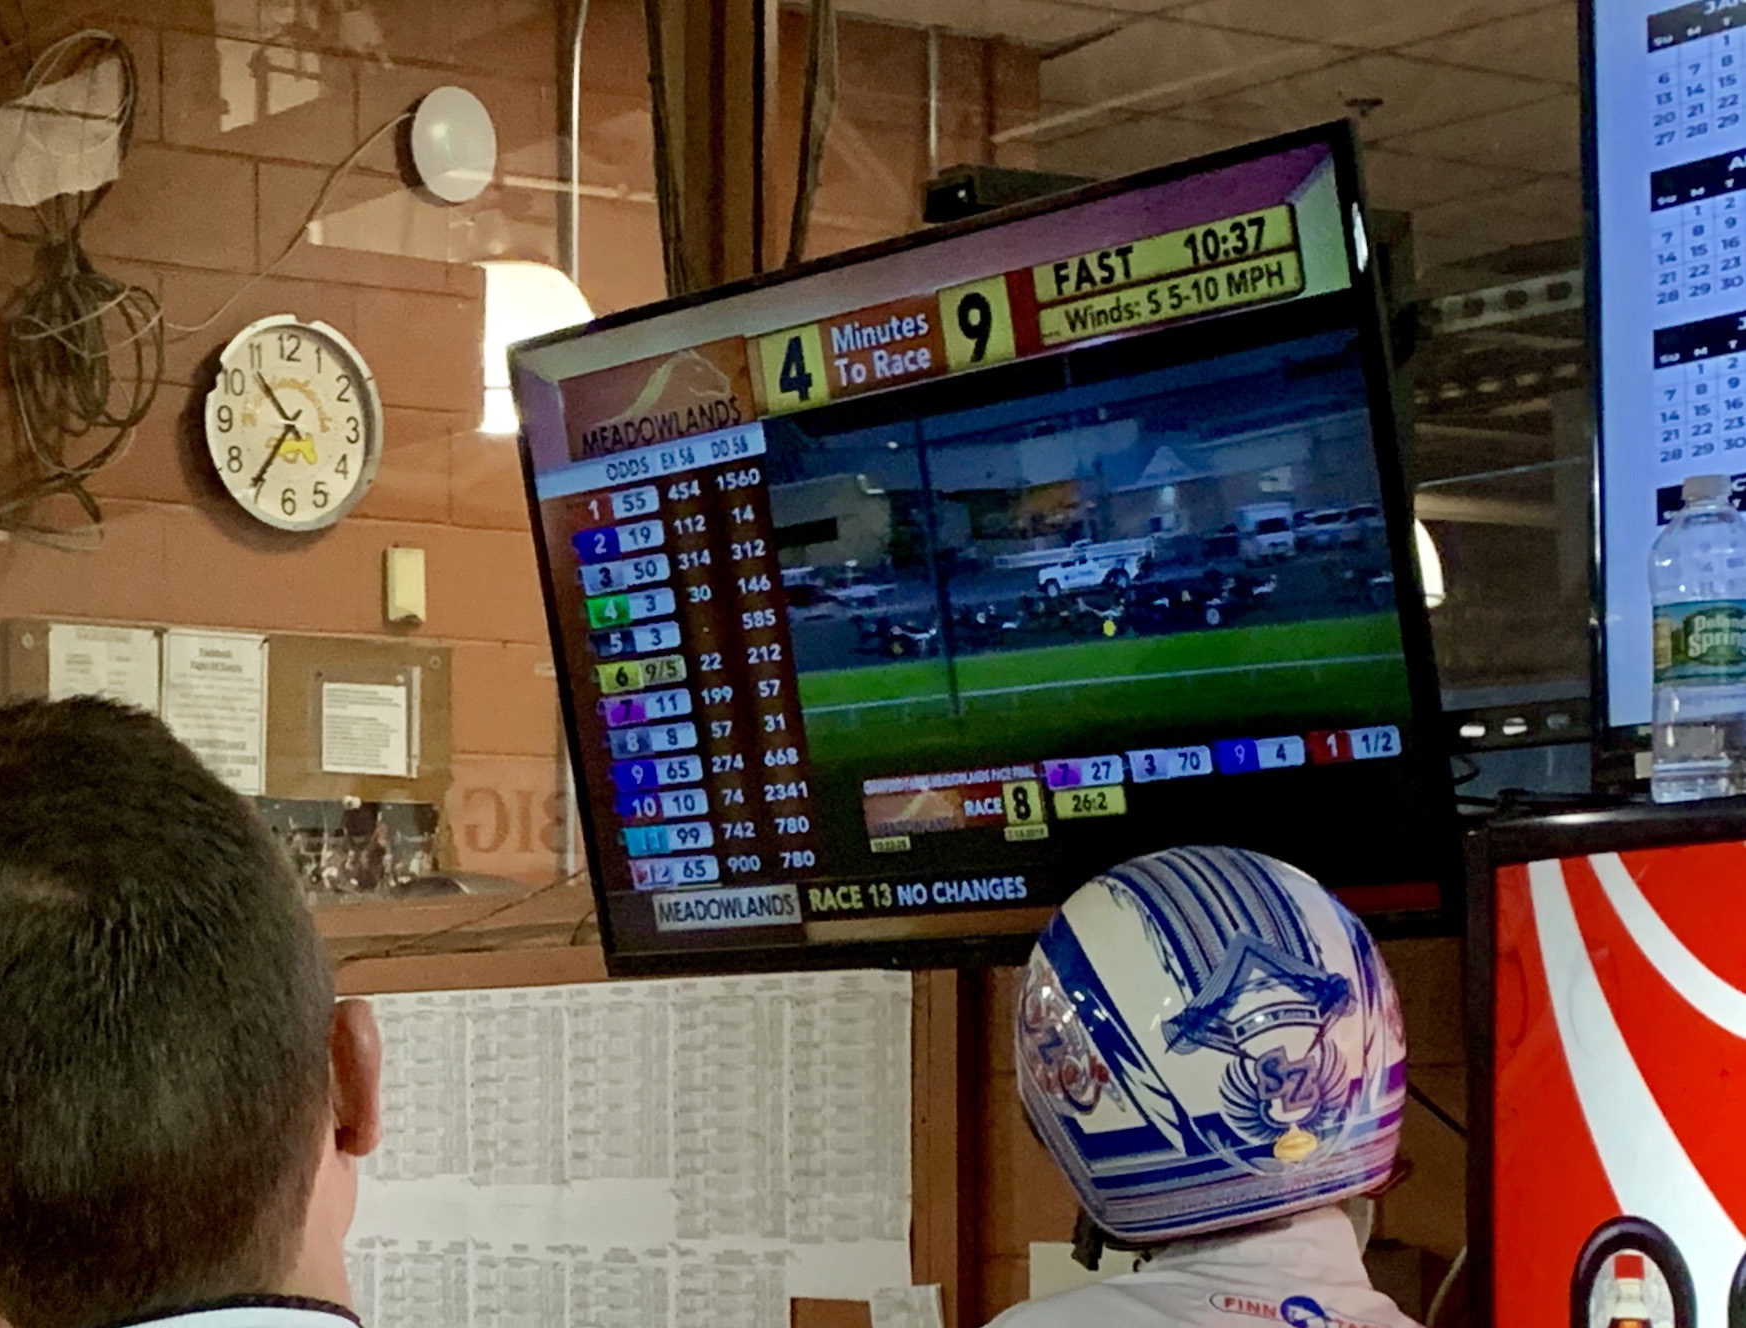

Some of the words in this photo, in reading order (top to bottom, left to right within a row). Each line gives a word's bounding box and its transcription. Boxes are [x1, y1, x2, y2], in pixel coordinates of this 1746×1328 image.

[1688, 63, 1701, 76] 7
[1686, 83, 1705, 97] 14
[1718, 73, 1737, 88] 15
[1653, 111, 1675, 127] 20
[1687, 103, 1704, 118] 21
[1717, 93, 1738, 109] 22
[1655, 130, 1675, 146] 27
[1685, 122, 1708, 138] 28
[1717, 113, 1739, 129] 29
[1724, 196, 1735, 210] 2
[1657, 252, 1677, 265] 14
[1690, 243, 1708, 257] 15
[1721, 236, 1741, 250] 16
[1661, 231, 1673, 244] 7
[1053, 245, 1134, 296] FAST
[1183, 216, 1266, 266] 10:37
[1659, 271, 1676, 286] 21
[1689, 263, 1710, 278] 22
[1721, 256, 1741, 272] 23
[1064, 295, 1141, 334] Winds:
[1167, 276, 1220, 311] 5-10
[1225, 260, 1285, 297] MPH
[1656, 289, 1679, 306] 28
[1688, 282, 1711, 298] 29
[1720, 275, 1744, 291] 30
[830, 312, 930, 355] Minutes
[957, 292, 993, 363] 9
[248, 342, 262, 370] 11
[277, 333, 302, 363] 12
[315, 345, 324, 374] 1
[1727, 356, 1738, 370] 2
[779, 335, 812, 401] 4
[833, 357, 867, 387] To
[872, 346, 932, 379] Race
[221, 367, 246, 397] 10
[335, 373, 352, 403] 2
[1664, 388, 1676, 401] 7
[216, 404, 234, 434] 9
[1660, 410, 1679, 423] 14
[1694, 403, 1711, 416] 15
[1724, 397, 1744, 411] 16
[345, 416, 361, 445] 3
[580, 396, 742, 456] MEADOWLANDS
[1662, 428, 1679, 443] 21
[1691, 422, 1713, 437] 22
[1724, 416, 1745, 431] 23
[226, 445, 244, 474] 8
[1660, 448, 1682, 463] 28
[1692, 443, 1714, 457] 29
[1724, 436, 1746, 451] 30
[334, 453, 350, 480] 4
[606, 455, 650, 482] ODDS
[280, 487, 297, 516] 6
[312, 481, 329, 509] 5
[588, 500, 600, 521] 1
[621, 493, 647, 513] 55
[667, 480, 701, 501] 454
[715, 468, 761, 491] 1560
[593, 533, 607, 555] 2
[628, 526, 651, 545] 19
[673, 515, 706, 535] 112
[732, 504, 755, 524] 14
[599, 567, 613, 588] 3
[633, 560, 658, 580] 50
[678, 549, 712, 570] 314
[731, 539, 767, 561] 312
[605, 600, 618, 620] 4
[645, 594, 657, 613] 3
[687, 584, 712, 603] 30
[737, 575, 771, 595] 146
[609, 633, 622, 653] 5
[651, 628, 662, 646] 3
[742, 608, 777, 630] 585
[615, 666, 629, 687] 6
[645, 660, 678, 681] 9/5
[700, 652, 722, 671] 22
[747, 643, 782, 665] 212
[620, 699, 634, 721] 7
[656, 693, 678, 714] 11
[701, 685, 733, 705] 199
[758, 679, 781, 698] 57
[625, 732, 639, 753] 8
[711, 720, 733, 739] 57
[763, 713, 786, 733] 31
[631, 763, 644, 784] 9
[666, 761, 690, 780] 65
[711, 753, 745, 773] 274
[763, 747, 799, 768] 668
[1057, 762, 1069, 781] 7
[1090, 760, 1111, 782] 27
[1144, 753, 1157, 776] 3
[1178, 750, 1201, 773] 70
[1233, 743, 1245, 766] 9
[1276, 743, 1287, 763] 4
[1326, 733, 1338, 758] 1
[1360, 732, 1393, 754] 1/2
[631, 797, 657, 818] 10
[672, 794, 696, 812] 10
[722, 788, 745, 807] 74
[763, 781, 809, 803] 2341
[963, 796, 1003, 817] RACE
[1012, 785, 1032, 821] 8
[1072, 791, 1108, 813] 26:2
[676, 827, 701, 845] 99
[722, 822, 756, 840] 742
[774, 816, 810, 836] 780
[683, 860, 707, 879] 65
[727, 855, 762, 874] 900
[780, 849, 816, 870] 780
[657, 893, 796, 924] MEADOWLANDS
[808, 884, 865, 912] RACE
[868, 882, 893, 908] 13
[896, 882, 929, 907] NO
[932, 875, 1029, 905] CHANGES
[1224, 1296, 1278, 1319] FINN
